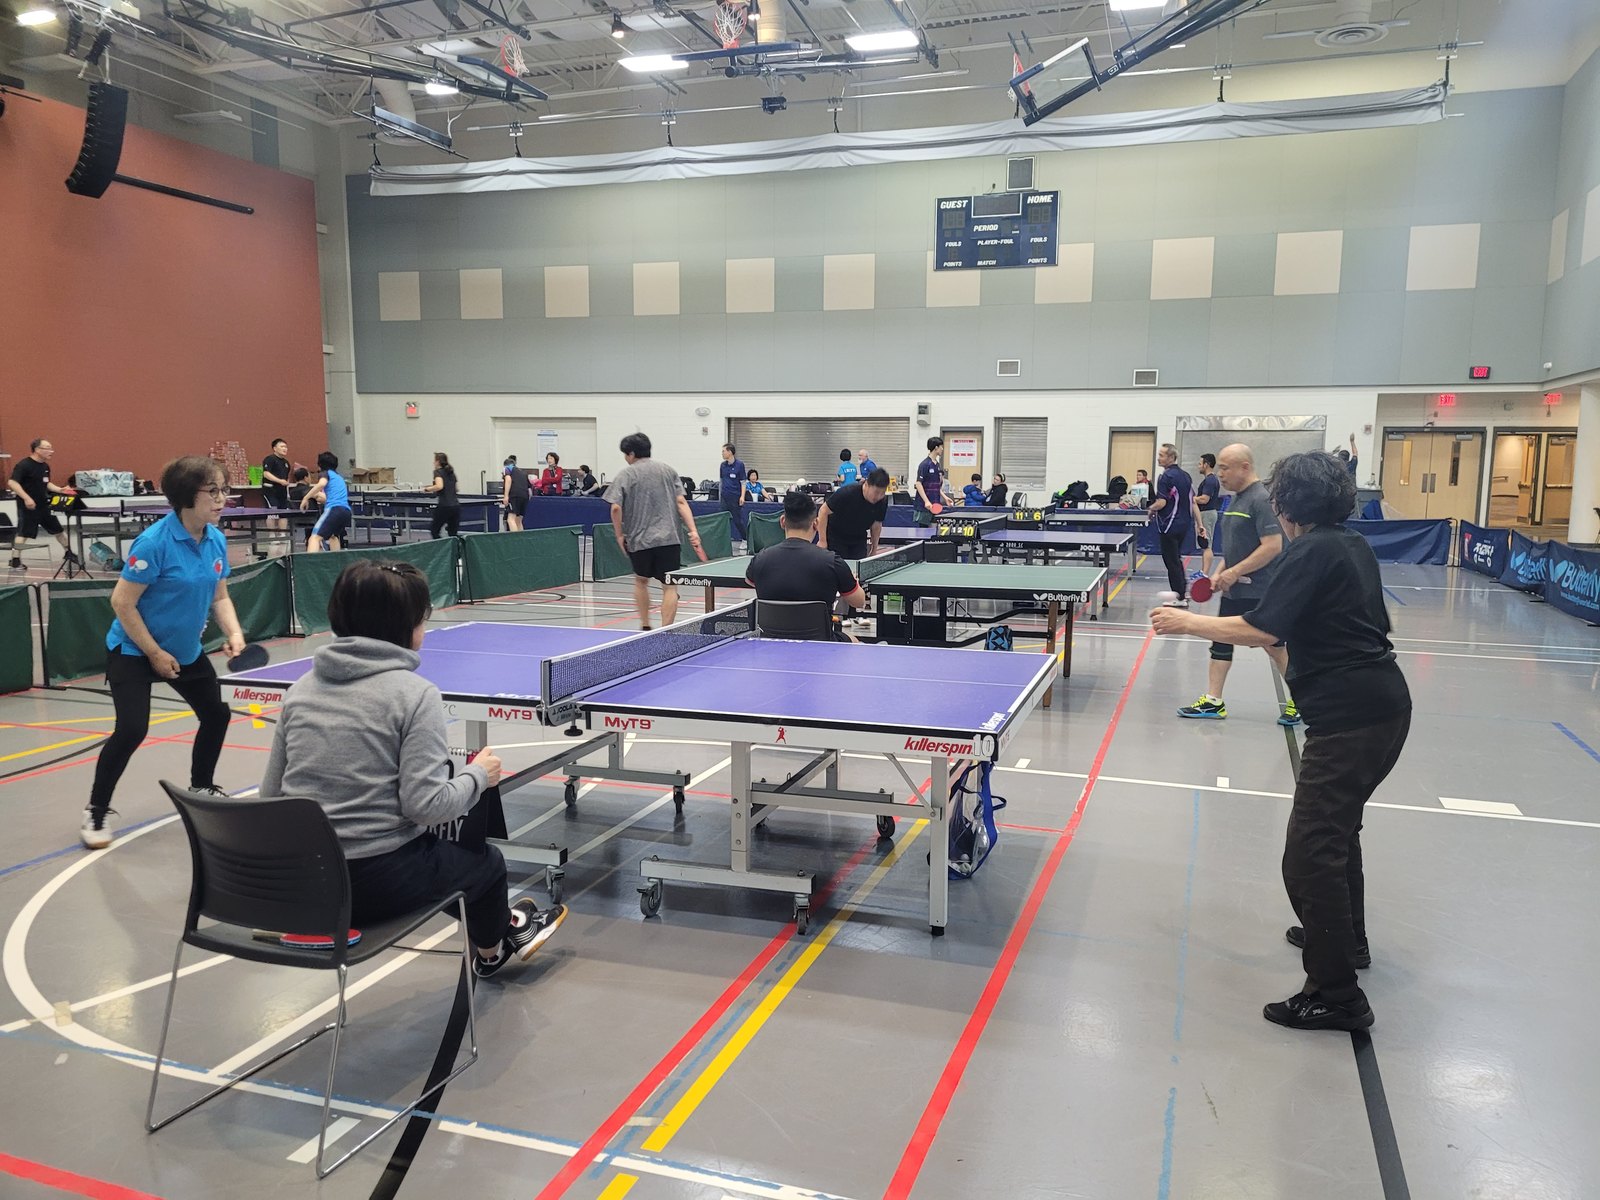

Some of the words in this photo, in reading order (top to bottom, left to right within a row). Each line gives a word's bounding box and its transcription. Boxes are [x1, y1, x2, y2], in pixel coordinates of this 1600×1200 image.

[940, 199, 968, 209] GUEST
[1027, 194, 1053, 204] HOME
[973, 224, 998, 232] PERIOD
[977, 238, 1014, 246] PLAYER-FOUL
[1016, 511, 1023, 520] 11
[1033, 512, 1041, 520] 6
[940, 526, 949, 536] 7
[963, 526, 974, 536] 10
[665, 574, 671, 584] 8
[684, 577, 711, 587] Butterfly
[1047, 592, 1080, 603] Butterfly
[1080, 591, 1088, 602] 8
[233, 688, 282, 703] killerspin
[489, 707, 532, 720] MyT9
[605, 716, 651, 730] MyT9
[904, 737, 973, 756] killerspin
[973, 733, 995, 757] 10
